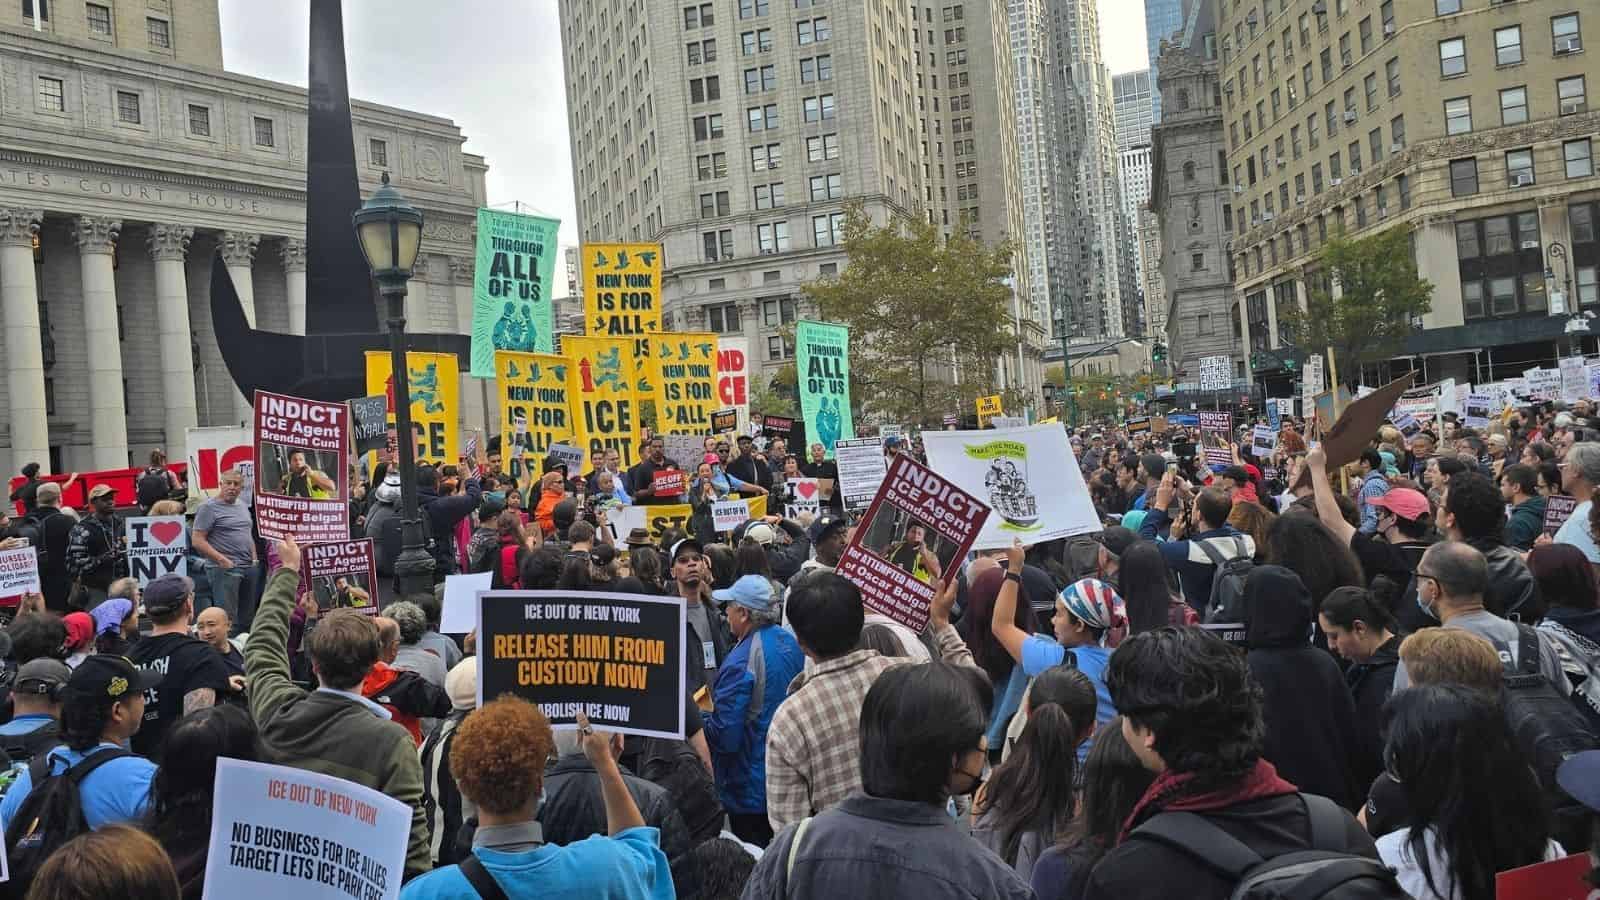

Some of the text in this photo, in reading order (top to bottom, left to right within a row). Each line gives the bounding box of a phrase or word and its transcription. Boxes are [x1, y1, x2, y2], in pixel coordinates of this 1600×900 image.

[79, 179, 164, 201] COURT
[189, 191, 258, 213] HOUSE
[491, 236, 544, 257] THROUGH
[490, 252, 541, 284] ALL
[488, 279, 541, 302] OF US
[596, 273, 652, 289] NEW YORK
[597, 292, 652, 311] IS FOR
[608, 315, 644, 335] ALL
[807, 343, 843, 358] THROUGH
[662, 364, 711, 379] NEW YORK
[808, 356, 844, 379] ALL
[508, 386, 565, 403] NEW YORK
[665, 382, 712, 400] IS FOR
[808, 378, 845, 395] OF US
[261, 396, 342, 424] INDICT
[355, 401, 383, 419] PASS
[508, 406, 565, 427] IS FOR
[584, 400, 632, 433] ICE
[676, 405, 707, 425] ALL
[1200, 412, 1229, 420] INDICT
[261, 416, 340, 439] ICE Agent
[261, 430, 339, 449] Brendan Cuni
[787, 482, 797, 500] I
[897, 459, 983, 520] INDICT
[268, 509, 299, 521] Oscar
[740, 506, 747, 514] NY
[891, 476, 973, 535] ICE Agent
[886, 489, 936, 525] Brendan
[938, 522, 966, 543] Cuni
[131, 523, 148, 548] I
[652, 516, 692, 538] ST
[0, 553, 27, 564] URSES
[129, 546, 185, 556] IMMIGRANT
[308, 541, 369, 559] INDICT
[131, 555, 182, 580] NY
[309, 555, 369, 569] ICE Agent
[845, 561, 857, 570] of
[857, 566, 892, 590] Oscar
[848, 547, 862, 560] for
[860, 554, 906, 585] ATTEMPTED
[905, 579, 936, 600] MURDE
[524, 604, 640, 623] ICE OUT OF NEW YORK
[907, 618, 923, 630] NYC
[1223, 631, 1246, 641] ICE OUT
[494, 634, 664, 665] RELEASE HIM FROM
[518, 660, 648, 690] CUSTODY NOW
[537, 702, 630, 721] ABOLISH ICE NOW
[269, 779, 378, 826] ICE OUT OF NEW YORK
[232, 822, 388, 890] NO BUSINESS FOR ICE ALLIES.
[230, 845, 280, 874] TARGET
[283, 854, 313, 880] LETS
[317, 863, 335, 886] ICE
[338, 870, 364, 899] PARK
